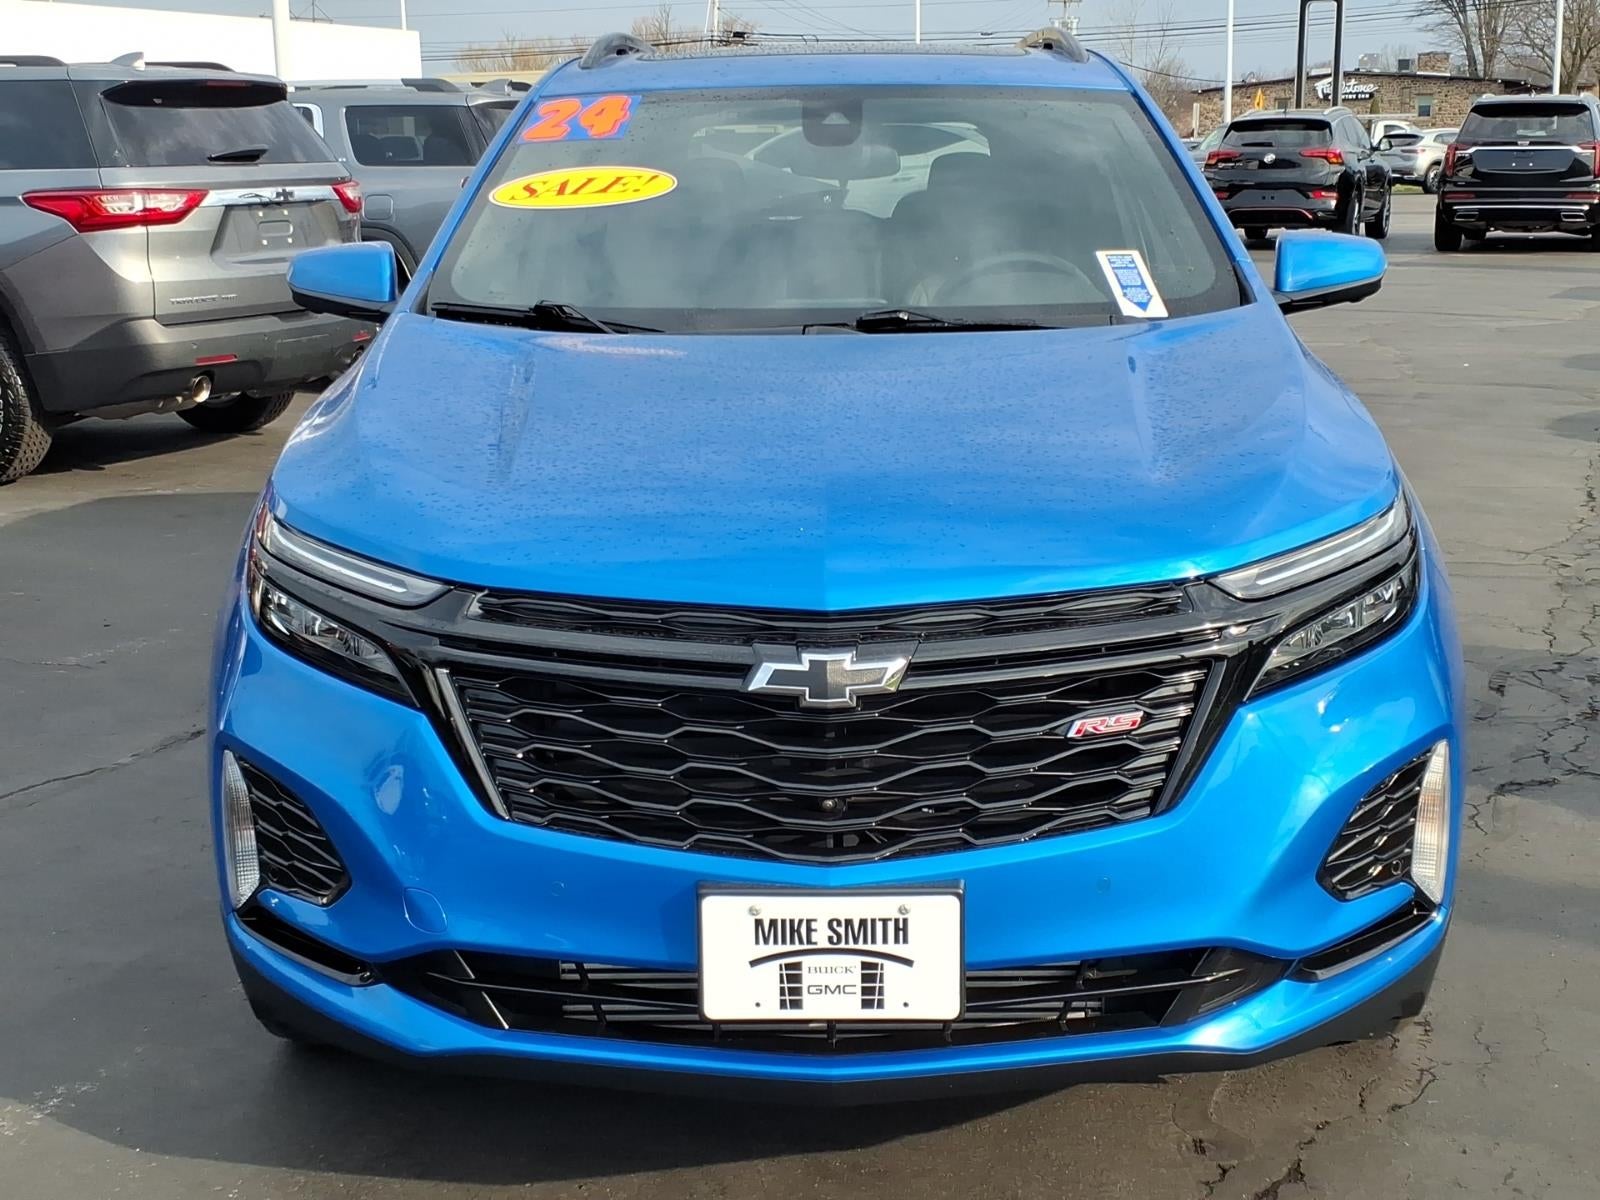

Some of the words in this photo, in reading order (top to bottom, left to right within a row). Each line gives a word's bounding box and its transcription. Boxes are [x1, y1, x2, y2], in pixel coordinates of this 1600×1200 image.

[522, 94, 632, 142] 24
[509, 174, 660, 201] SALE!
[1066, 710, 1144, 738] RS
[754, 918, 818, 946] MIKE
[827, 917, 909, 945] SMITH
[807, 965, 854, 975] BUICK
[807, 984, 857, 996] GMC
